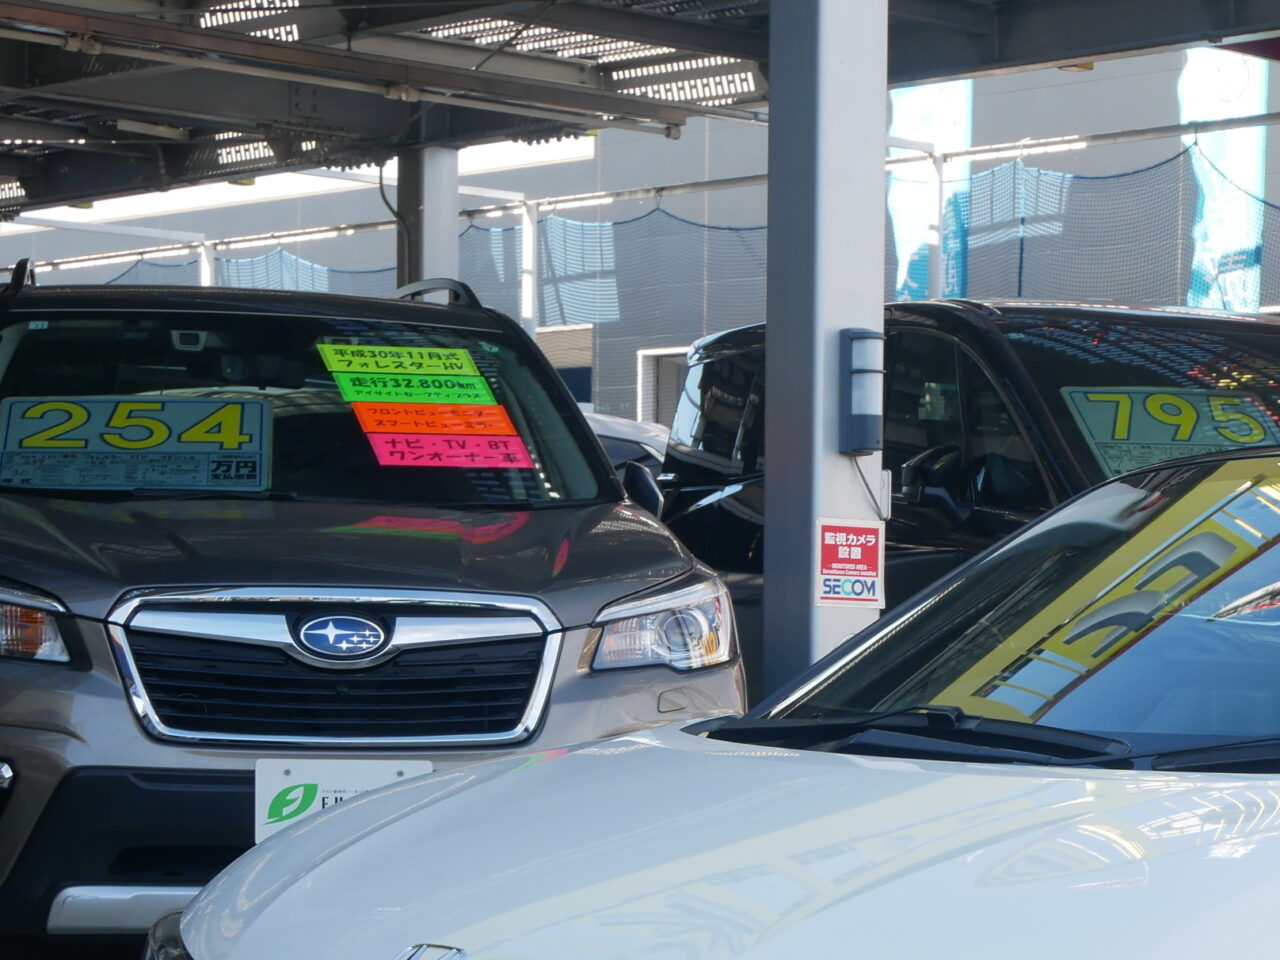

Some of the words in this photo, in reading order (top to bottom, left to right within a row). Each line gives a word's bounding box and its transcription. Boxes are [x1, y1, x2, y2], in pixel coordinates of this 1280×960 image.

[333, 348, 460, 361] 平成30年11月式
[337, 359, 464, 371] フォレスターHV
[1086, 393, 1267, 444] 795
[19, 401, 253, 450] 254
[388, 451, 520, 463] ワンオーナー車
[210, 460, 257, 473] 万円
[824, 532, 876, 546] 監視カメラ
[838, 546, 862, 559] 設置
[823, 578, 876, 597] SECOM
